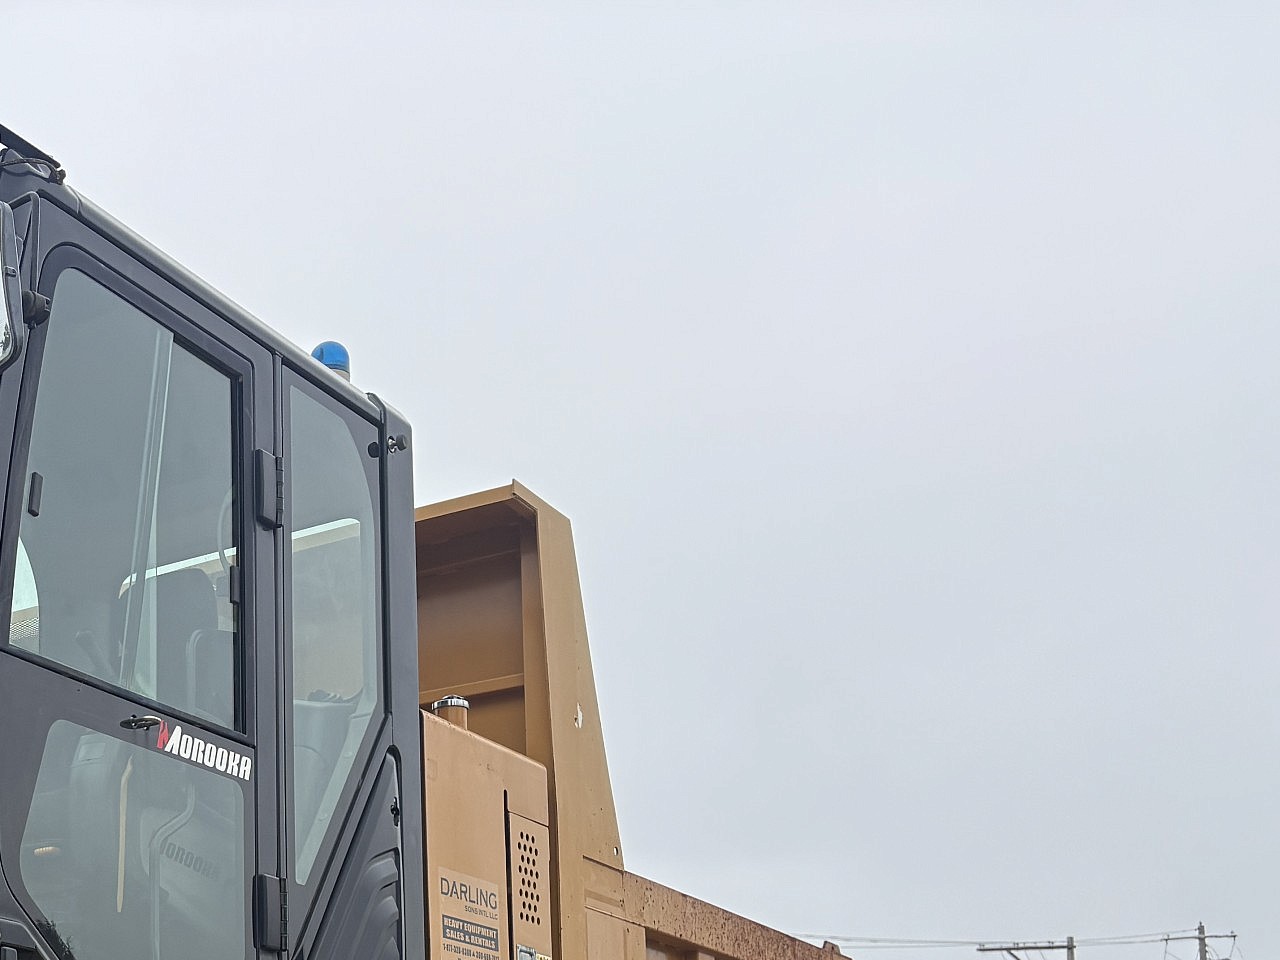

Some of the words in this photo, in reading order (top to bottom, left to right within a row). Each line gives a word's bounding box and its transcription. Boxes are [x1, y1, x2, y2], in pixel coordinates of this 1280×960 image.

[157, 720, 252, 781] MOROOKA
[440, 877, 498, 910] DARLING
[443, 917, 463, 930] HEAVY
[464, 923, 497, 939] EQUIPMENT
[445, 929, 465, 941] SALES
[471, 935, 496, 949] RENTALS
